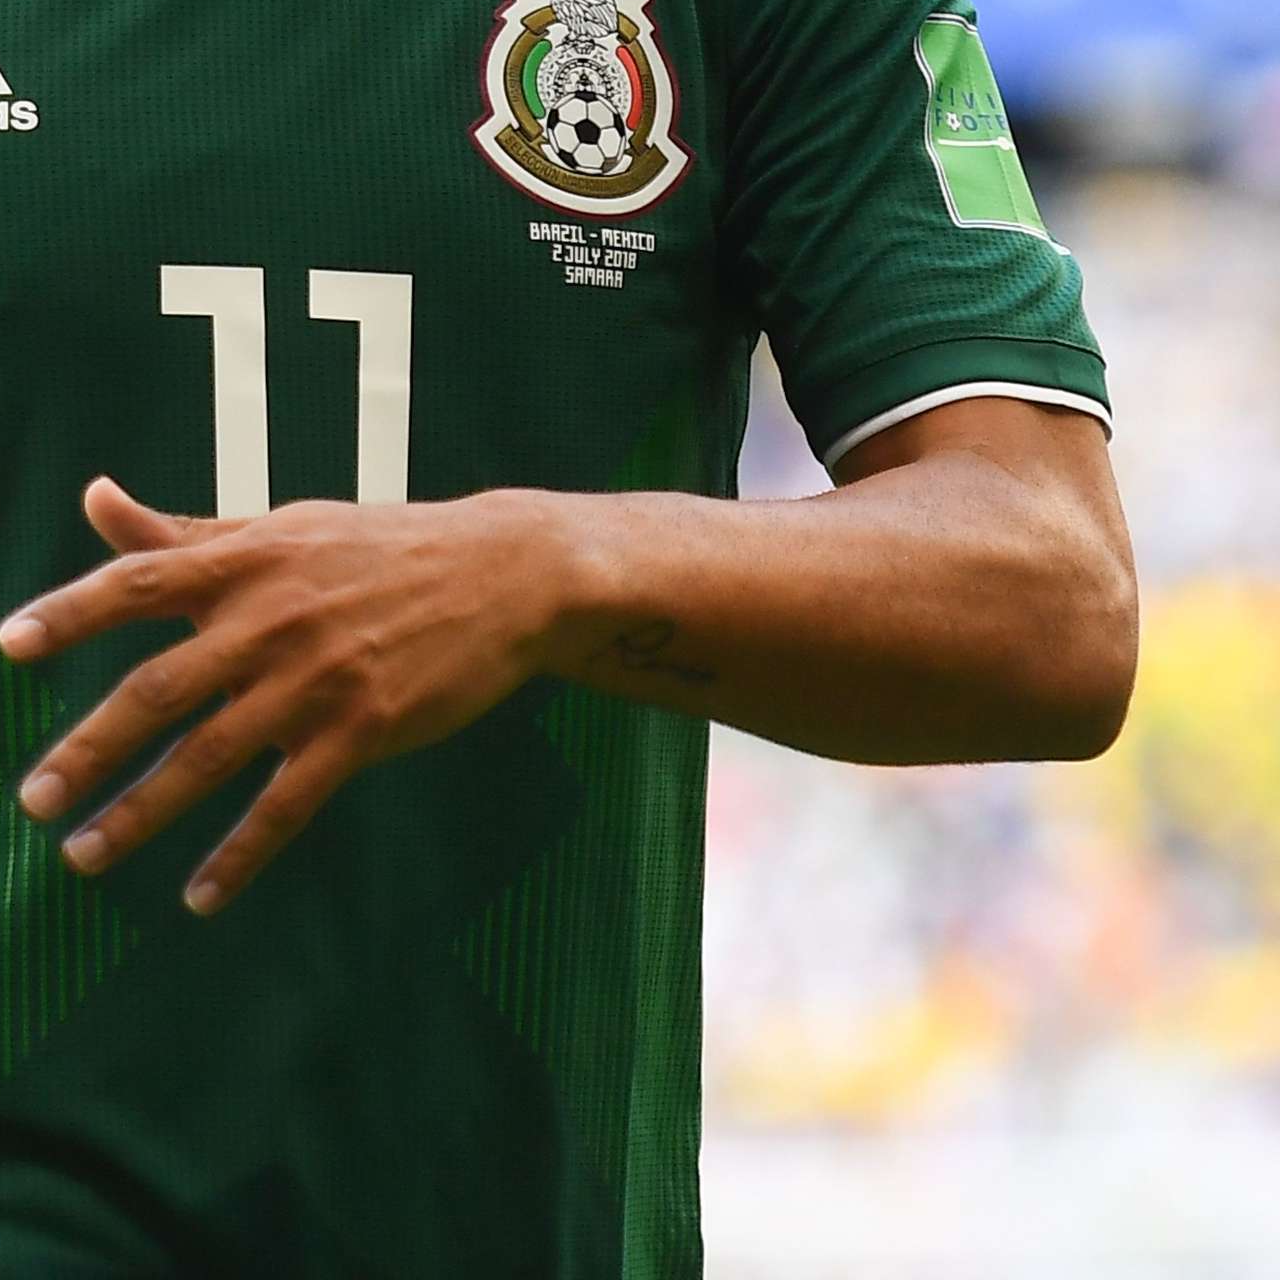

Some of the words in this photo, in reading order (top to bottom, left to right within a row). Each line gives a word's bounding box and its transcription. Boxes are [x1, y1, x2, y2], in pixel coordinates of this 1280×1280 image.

[529, 222, 587, 244] BRAZIL
[601, 228, 656, 252] MEXICO
[552, 243, 563, 262] 2
[564, 246, 601, 266] JULY
[604, 249, 638, 270] 2018
[565, 266, 624, 289] SAMARA
[160, 264, 413, 520] 11
